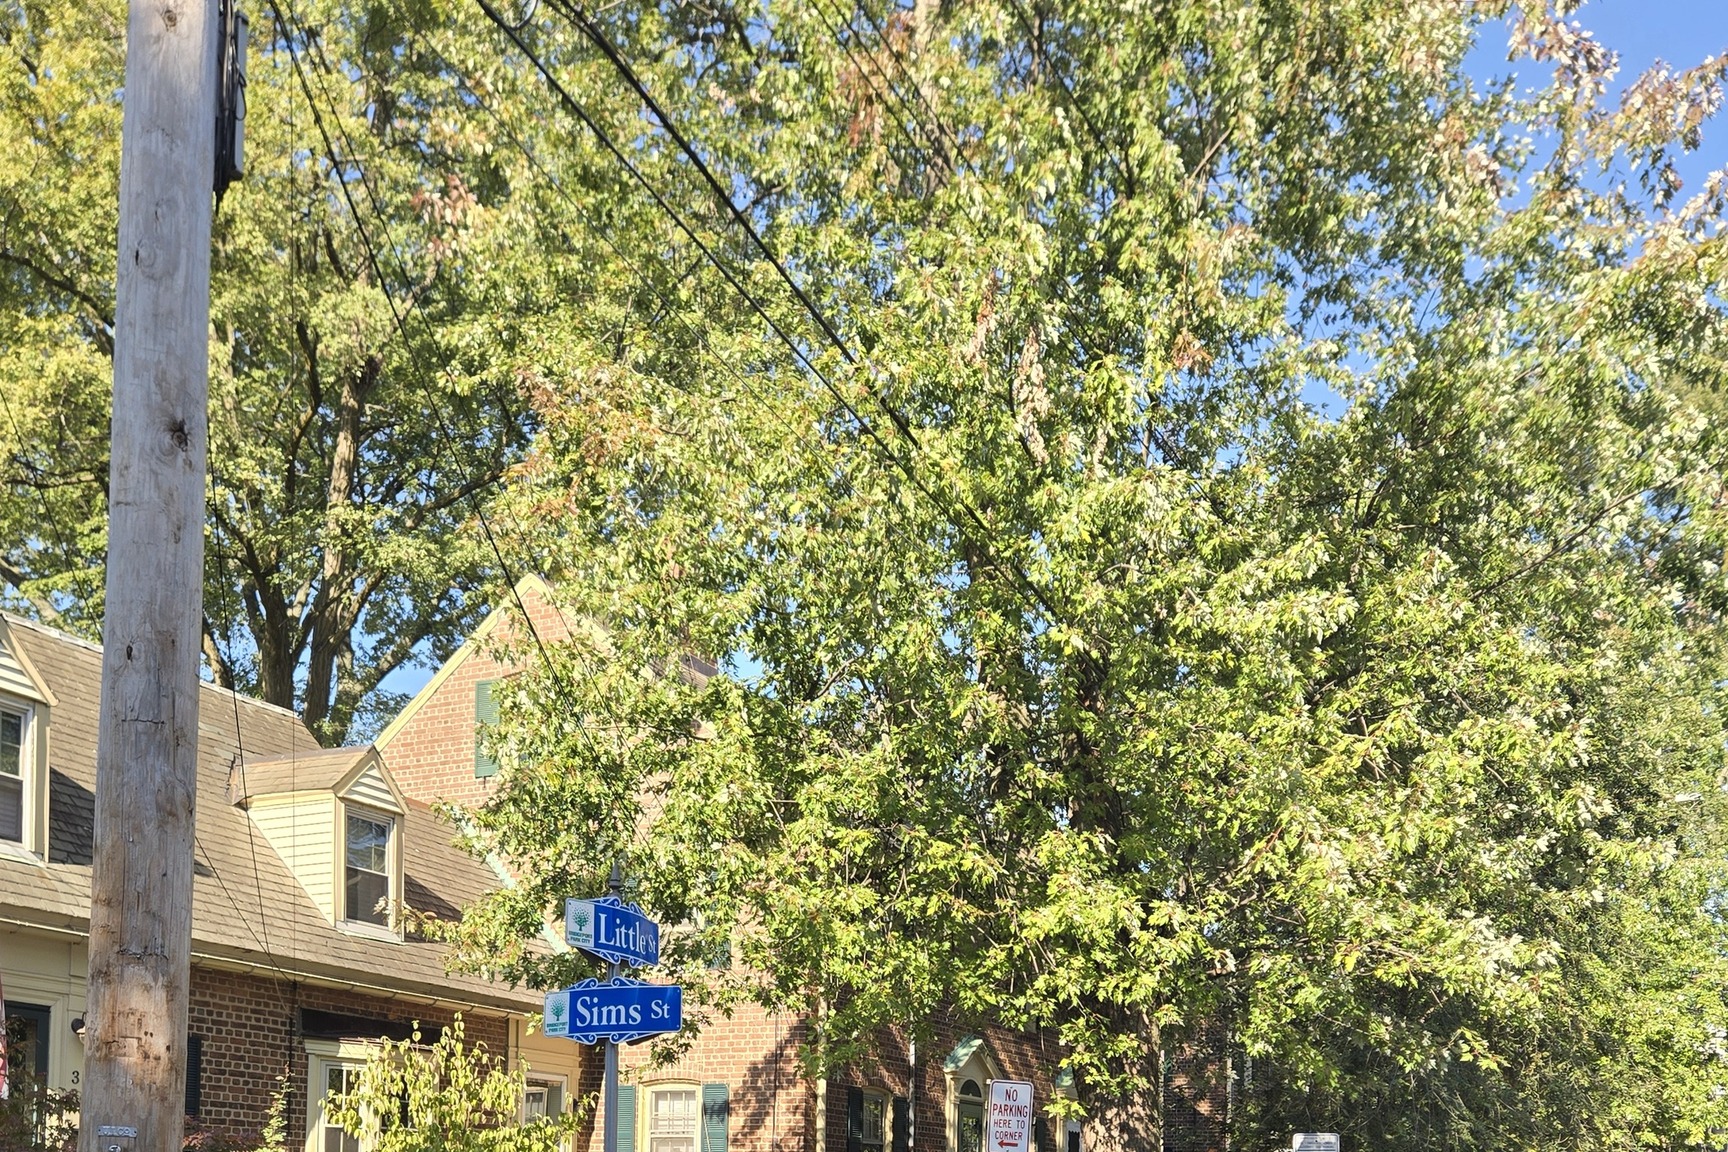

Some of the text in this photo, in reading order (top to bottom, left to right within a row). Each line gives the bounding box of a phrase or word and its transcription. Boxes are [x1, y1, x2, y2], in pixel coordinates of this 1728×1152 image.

[598, 912, 656, 955] Little St
[576, 996, 671, 1027] Sims St
[1005, 1088, 1018, 1102] NO
[992, 1103, 1029, 1118] PARKING
[993, 1118, 1026, 1130] HERE TO
[994, 1130, 1024, 1141] CORNER
